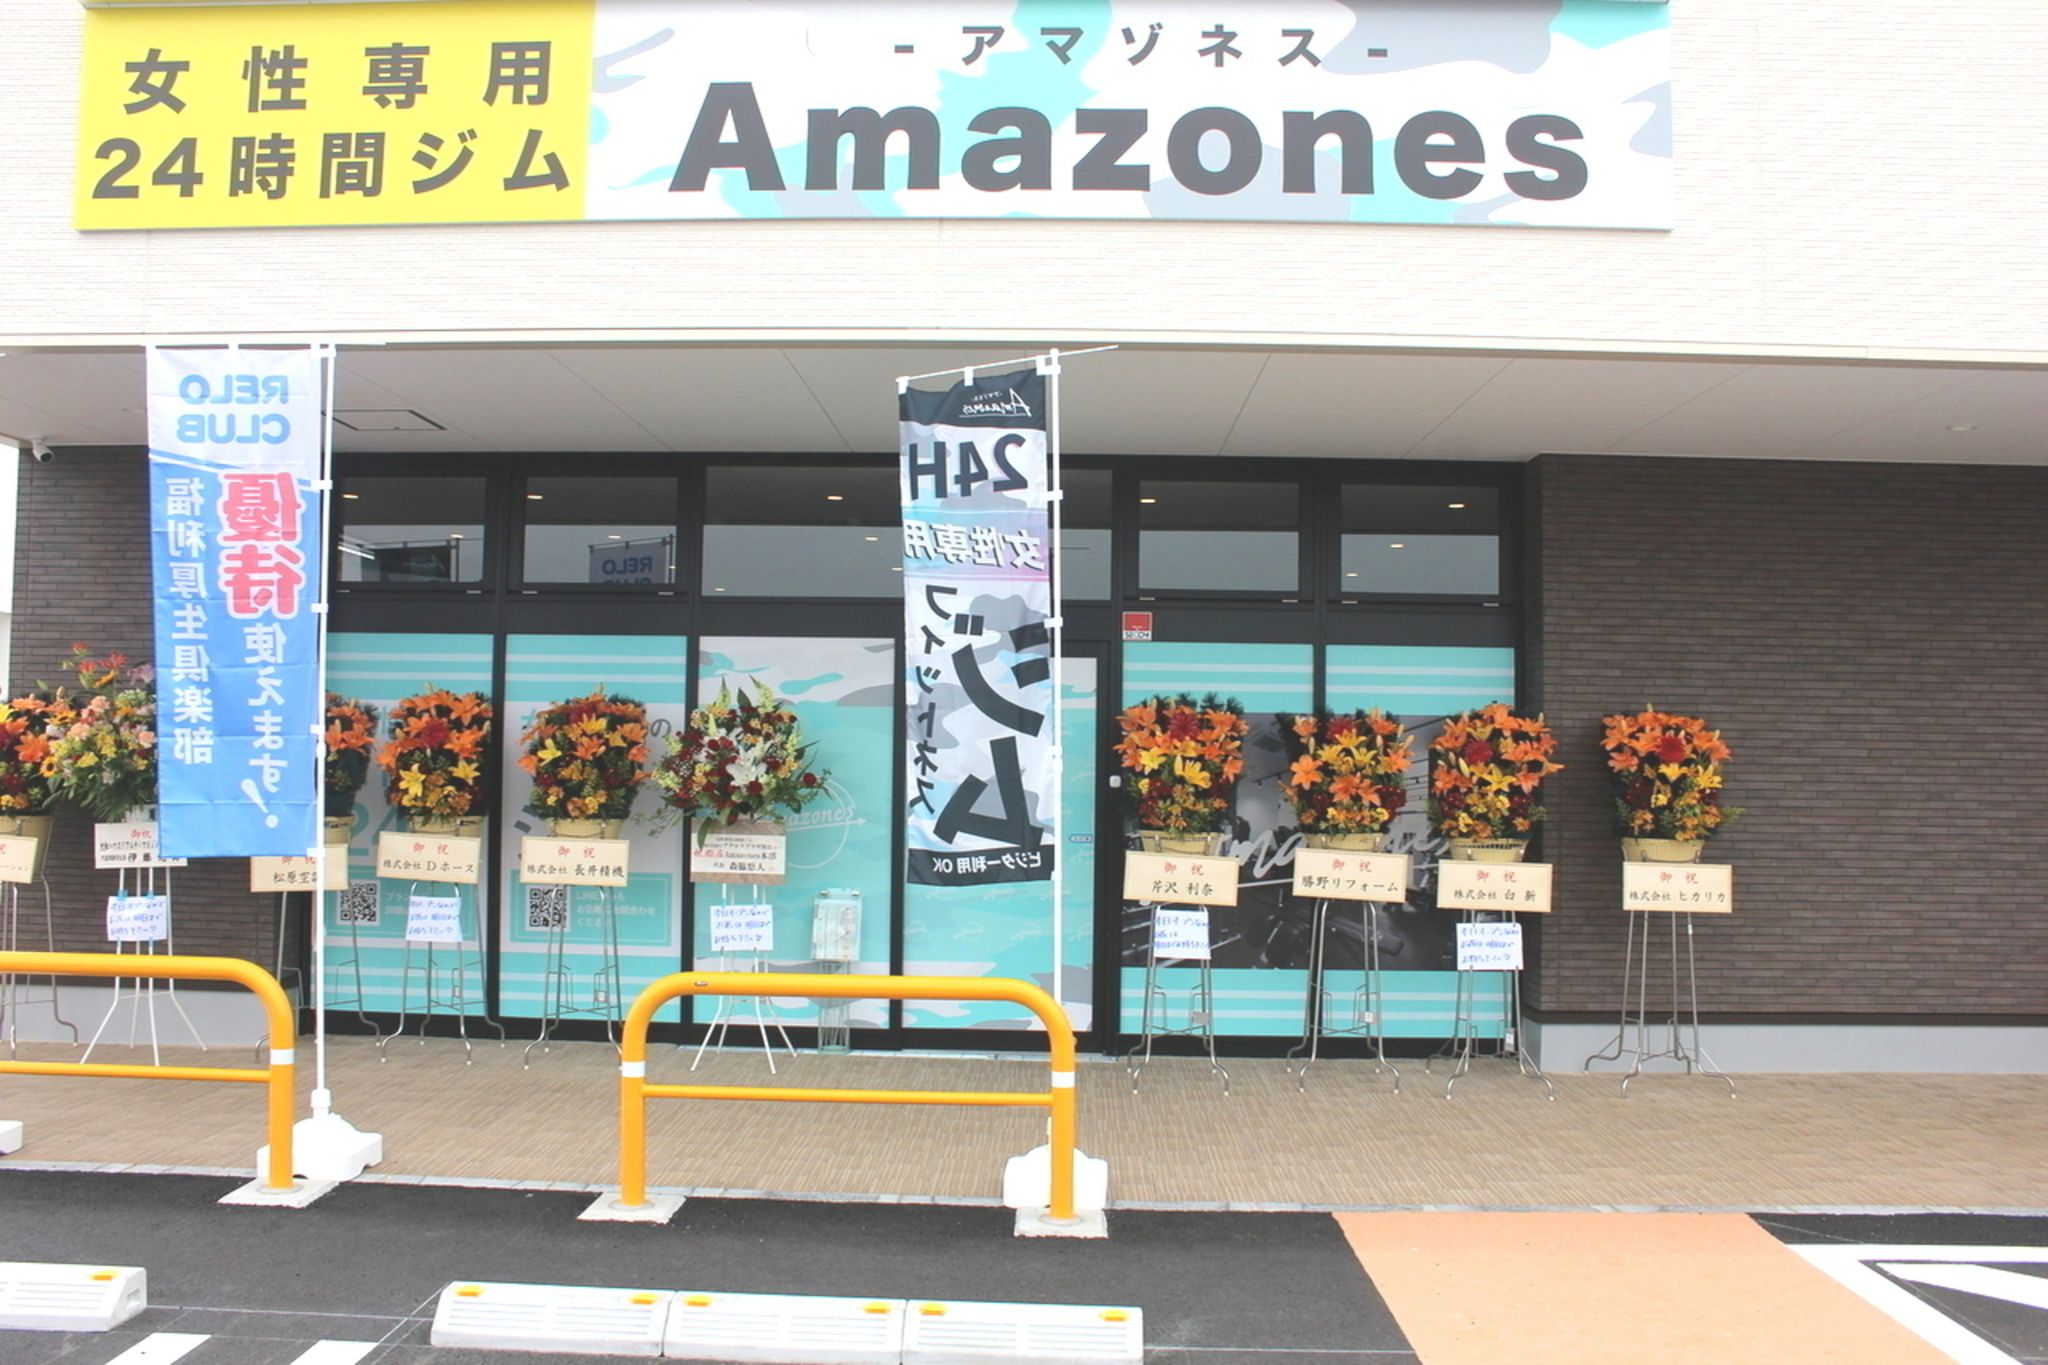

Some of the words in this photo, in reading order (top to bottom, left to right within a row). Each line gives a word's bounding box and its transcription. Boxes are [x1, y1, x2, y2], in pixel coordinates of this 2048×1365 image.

[123, 40, 552, 115] 女性専用
[91, 128, 571, 201] 24時間ジム
[667, 79, 1590, 201] Amazones
